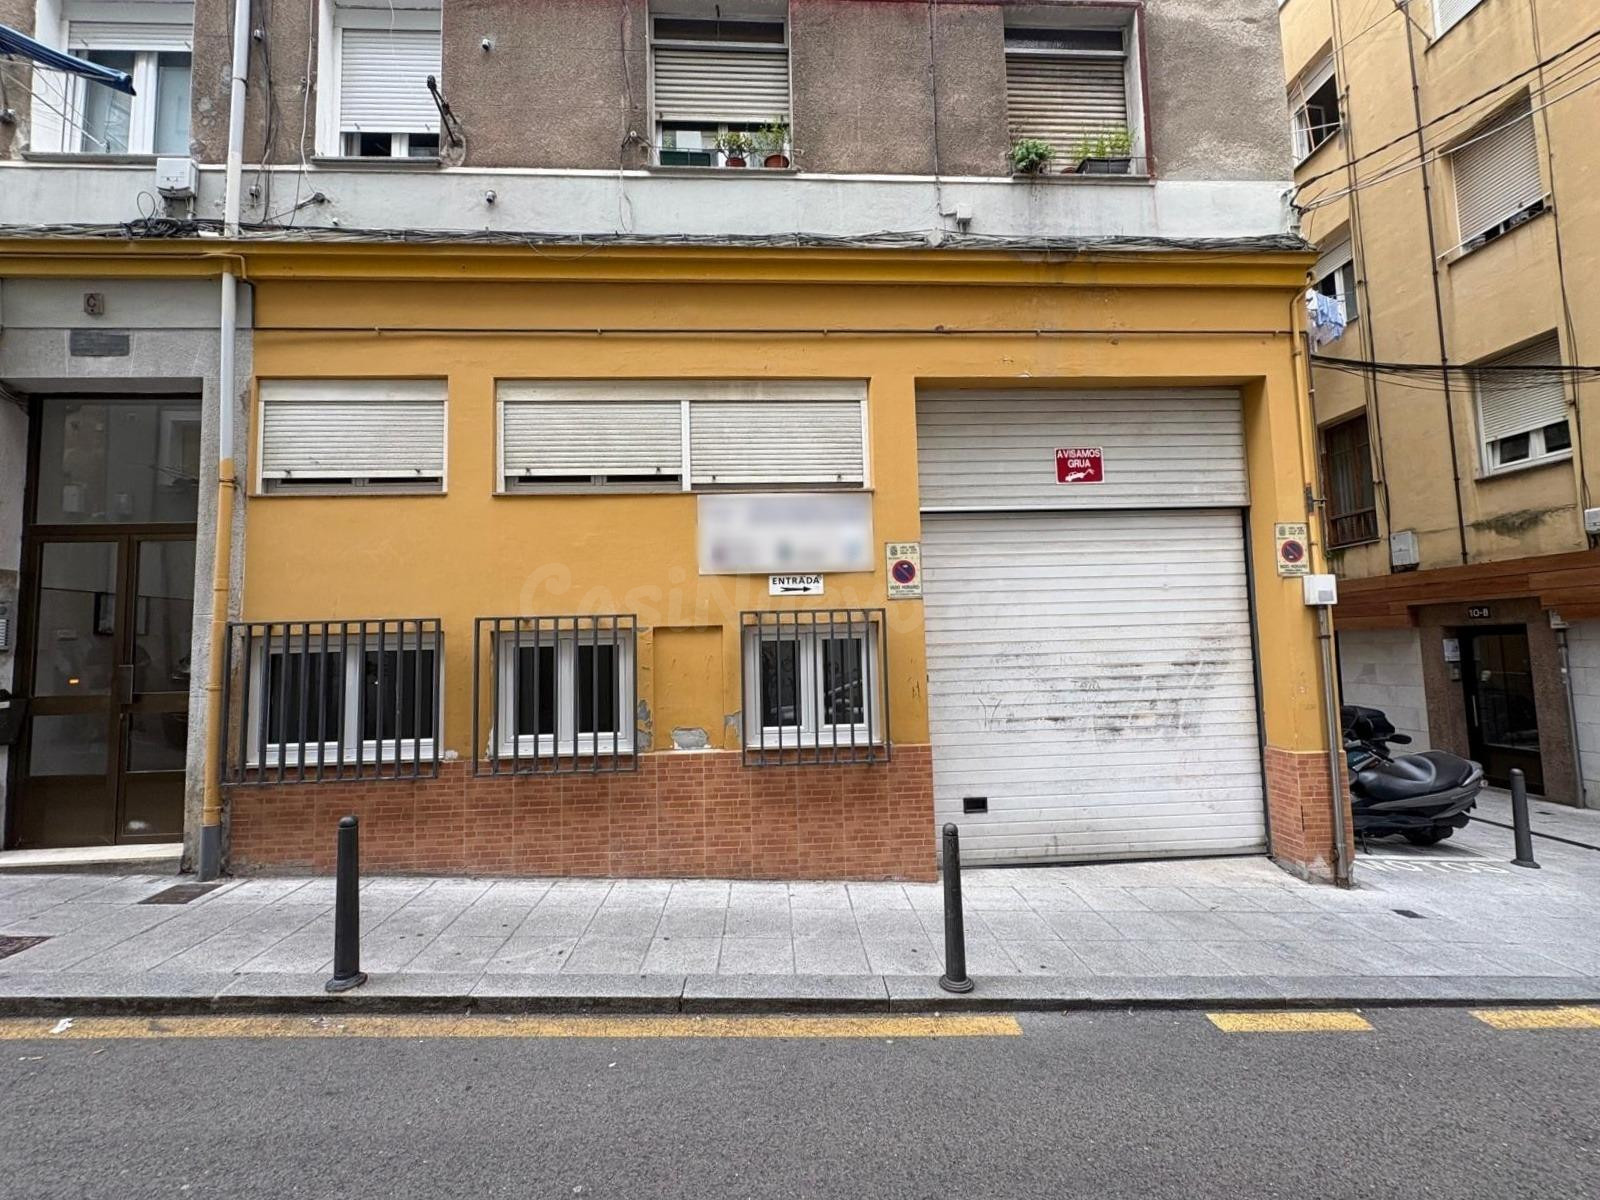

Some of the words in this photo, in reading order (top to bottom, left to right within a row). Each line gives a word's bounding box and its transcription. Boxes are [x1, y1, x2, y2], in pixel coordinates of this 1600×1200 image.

[1057, 449, 1101, 459] AVISAMOS
[1067, 459, 1091, 468] GRUA
[772, 576, 820, 585] ENTRADA
[1353, 859, 1510, 874] MOTOS
